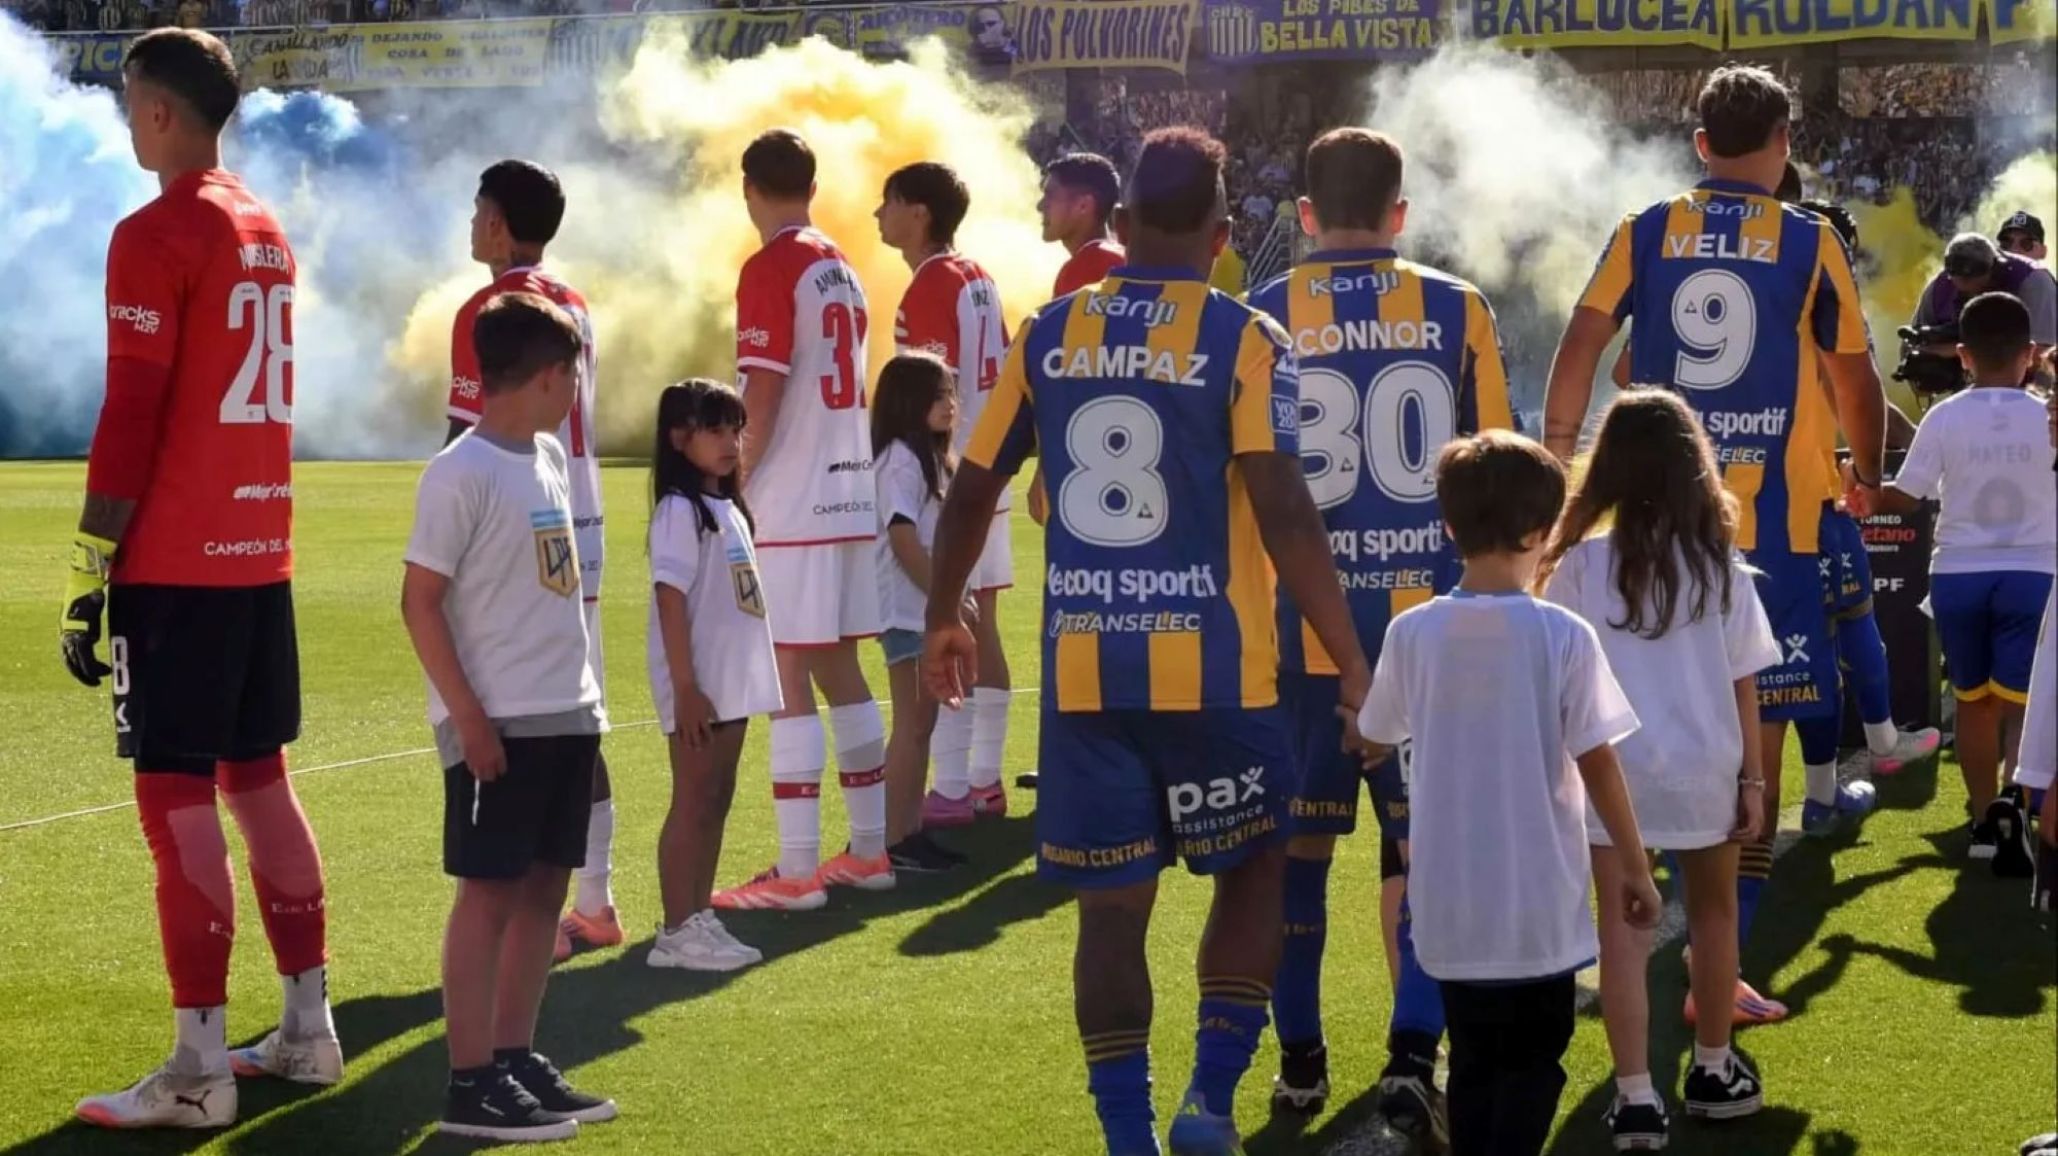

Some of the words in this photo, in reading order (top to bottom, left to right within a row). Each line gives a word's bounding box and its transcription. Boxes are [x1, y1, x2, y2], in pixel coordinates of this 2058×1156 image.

[1260, 20, 1348, 53] BELLA
[1355, 18, 1432, 49] VISTA
[1668, 232, 1775, 263] VELIZ
[1309, 270, 1400, 297] kanji
[1086, 290, 1177, 328] kanji
[1296, 319, 1443, 356] CONNOR
[1671, 268, 1757, 390] 9
[219, 282, 296, 424] 28
[1042, 344, 1209, 388] CAMPAZ
[1297, 360, 1457, 511] 30
[1707, 406, 1787, 440] sportif
[1058, 394, 1170, 548] 8
[204, 537, 267, 556] CAMPEÓN
[1063, 612, 1202, 633] TRANSELEC
[111, 636, 130, 696] 8
[1167, 765, 1265, 823] pax
[1172, 804, 1264, 834] assistance
[1215, 813, 1277, 852] CENTRAL
[1090, 836, 1157, 867] CENTRAL
